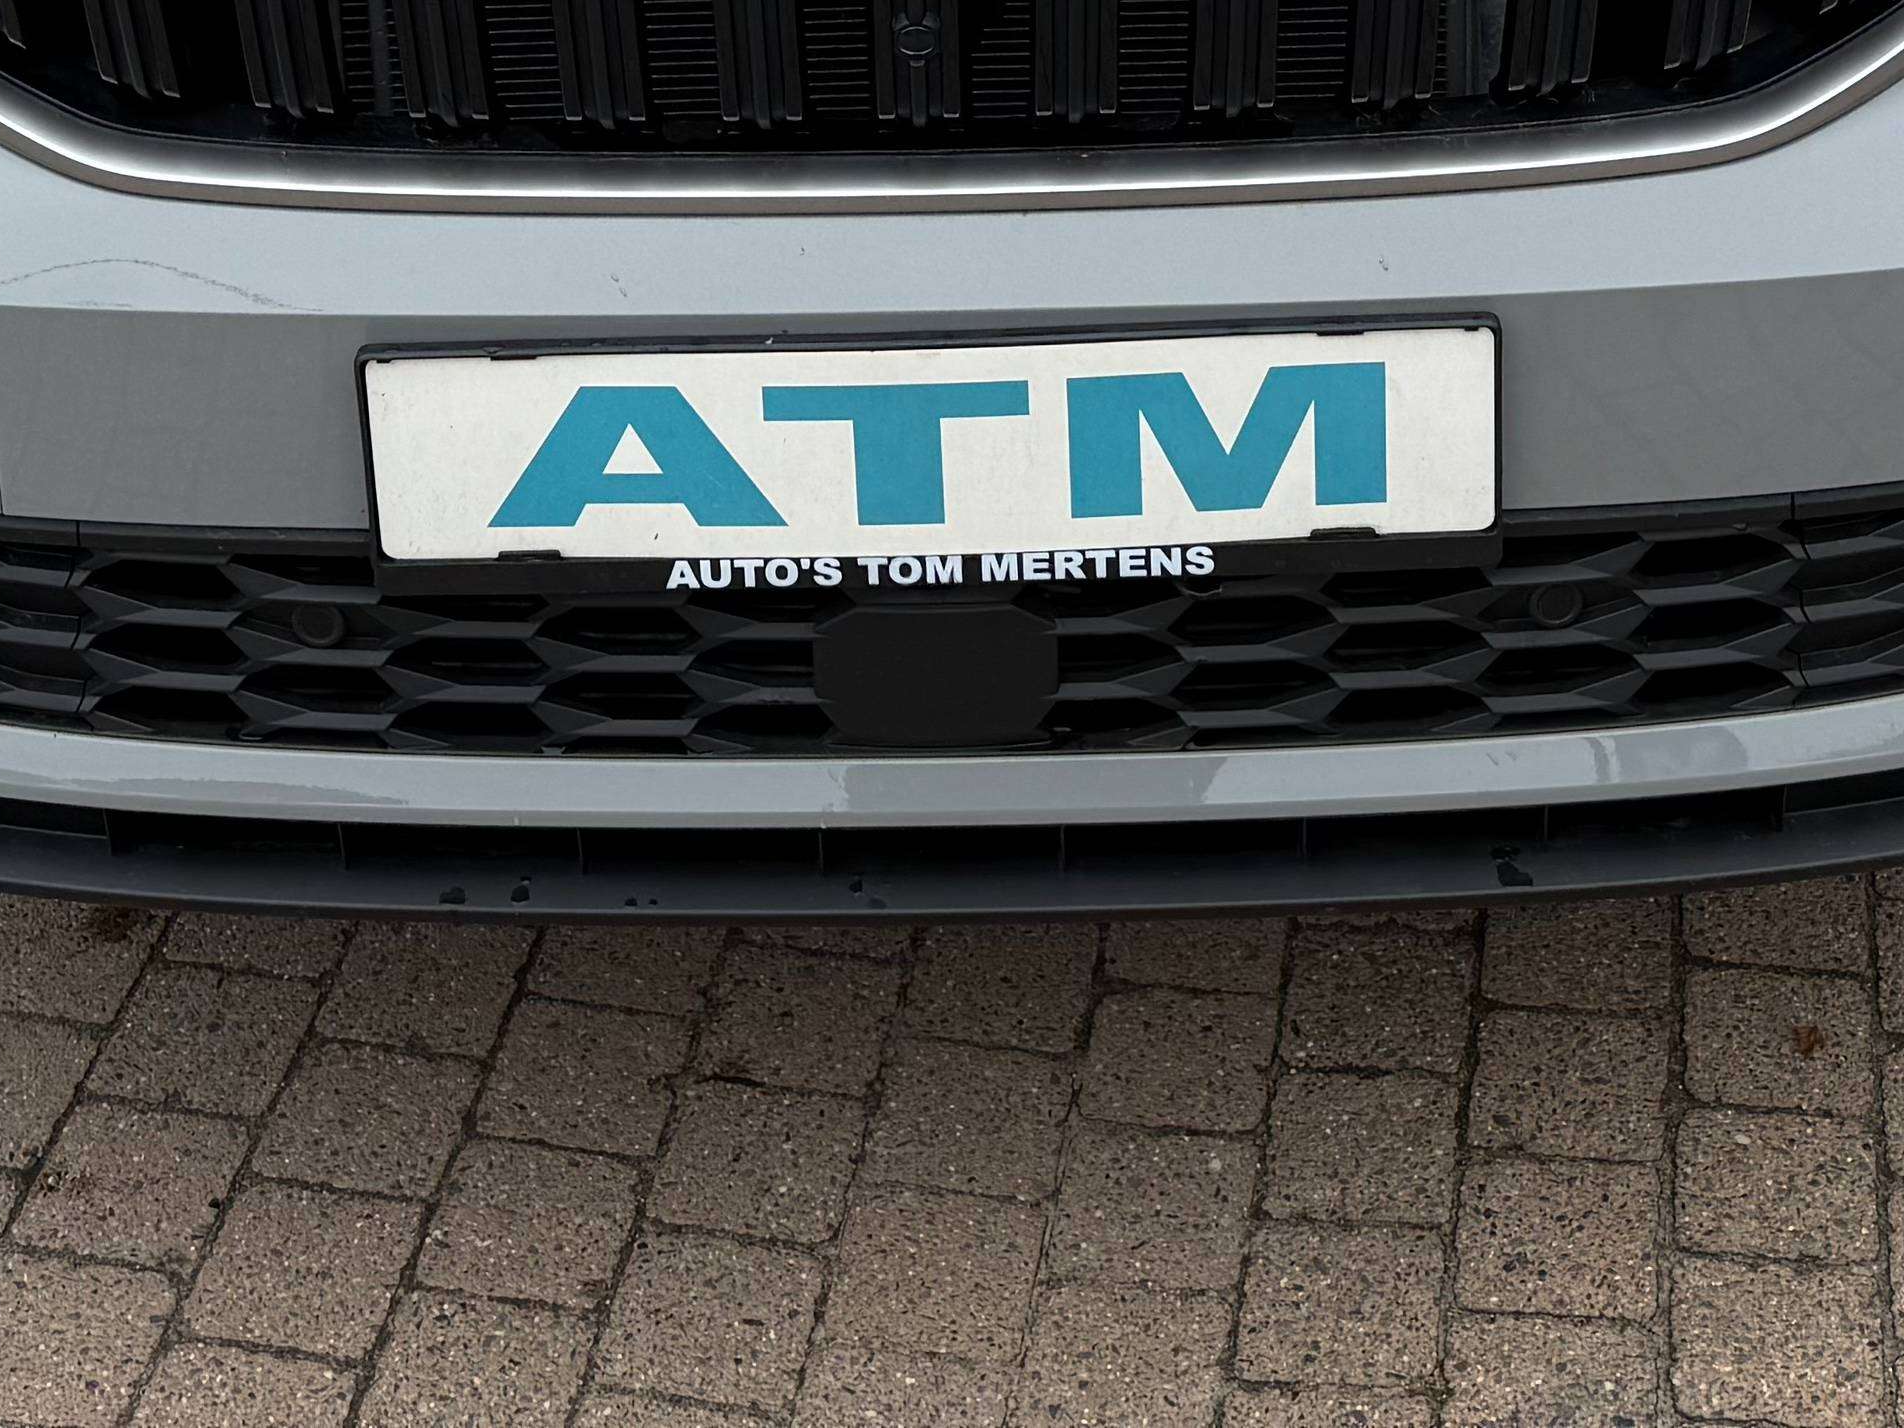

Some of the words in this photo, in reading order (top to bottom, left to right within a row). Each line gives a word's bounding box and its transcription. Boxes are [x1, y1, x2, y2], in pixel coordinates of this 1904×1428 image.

[486, 360, 1388, 528] ATM
[665, 557, 843, 590] AUTO'S
[857, 554, 963, 586] TOM
[981, 546, 1215, 583] MERTENS
